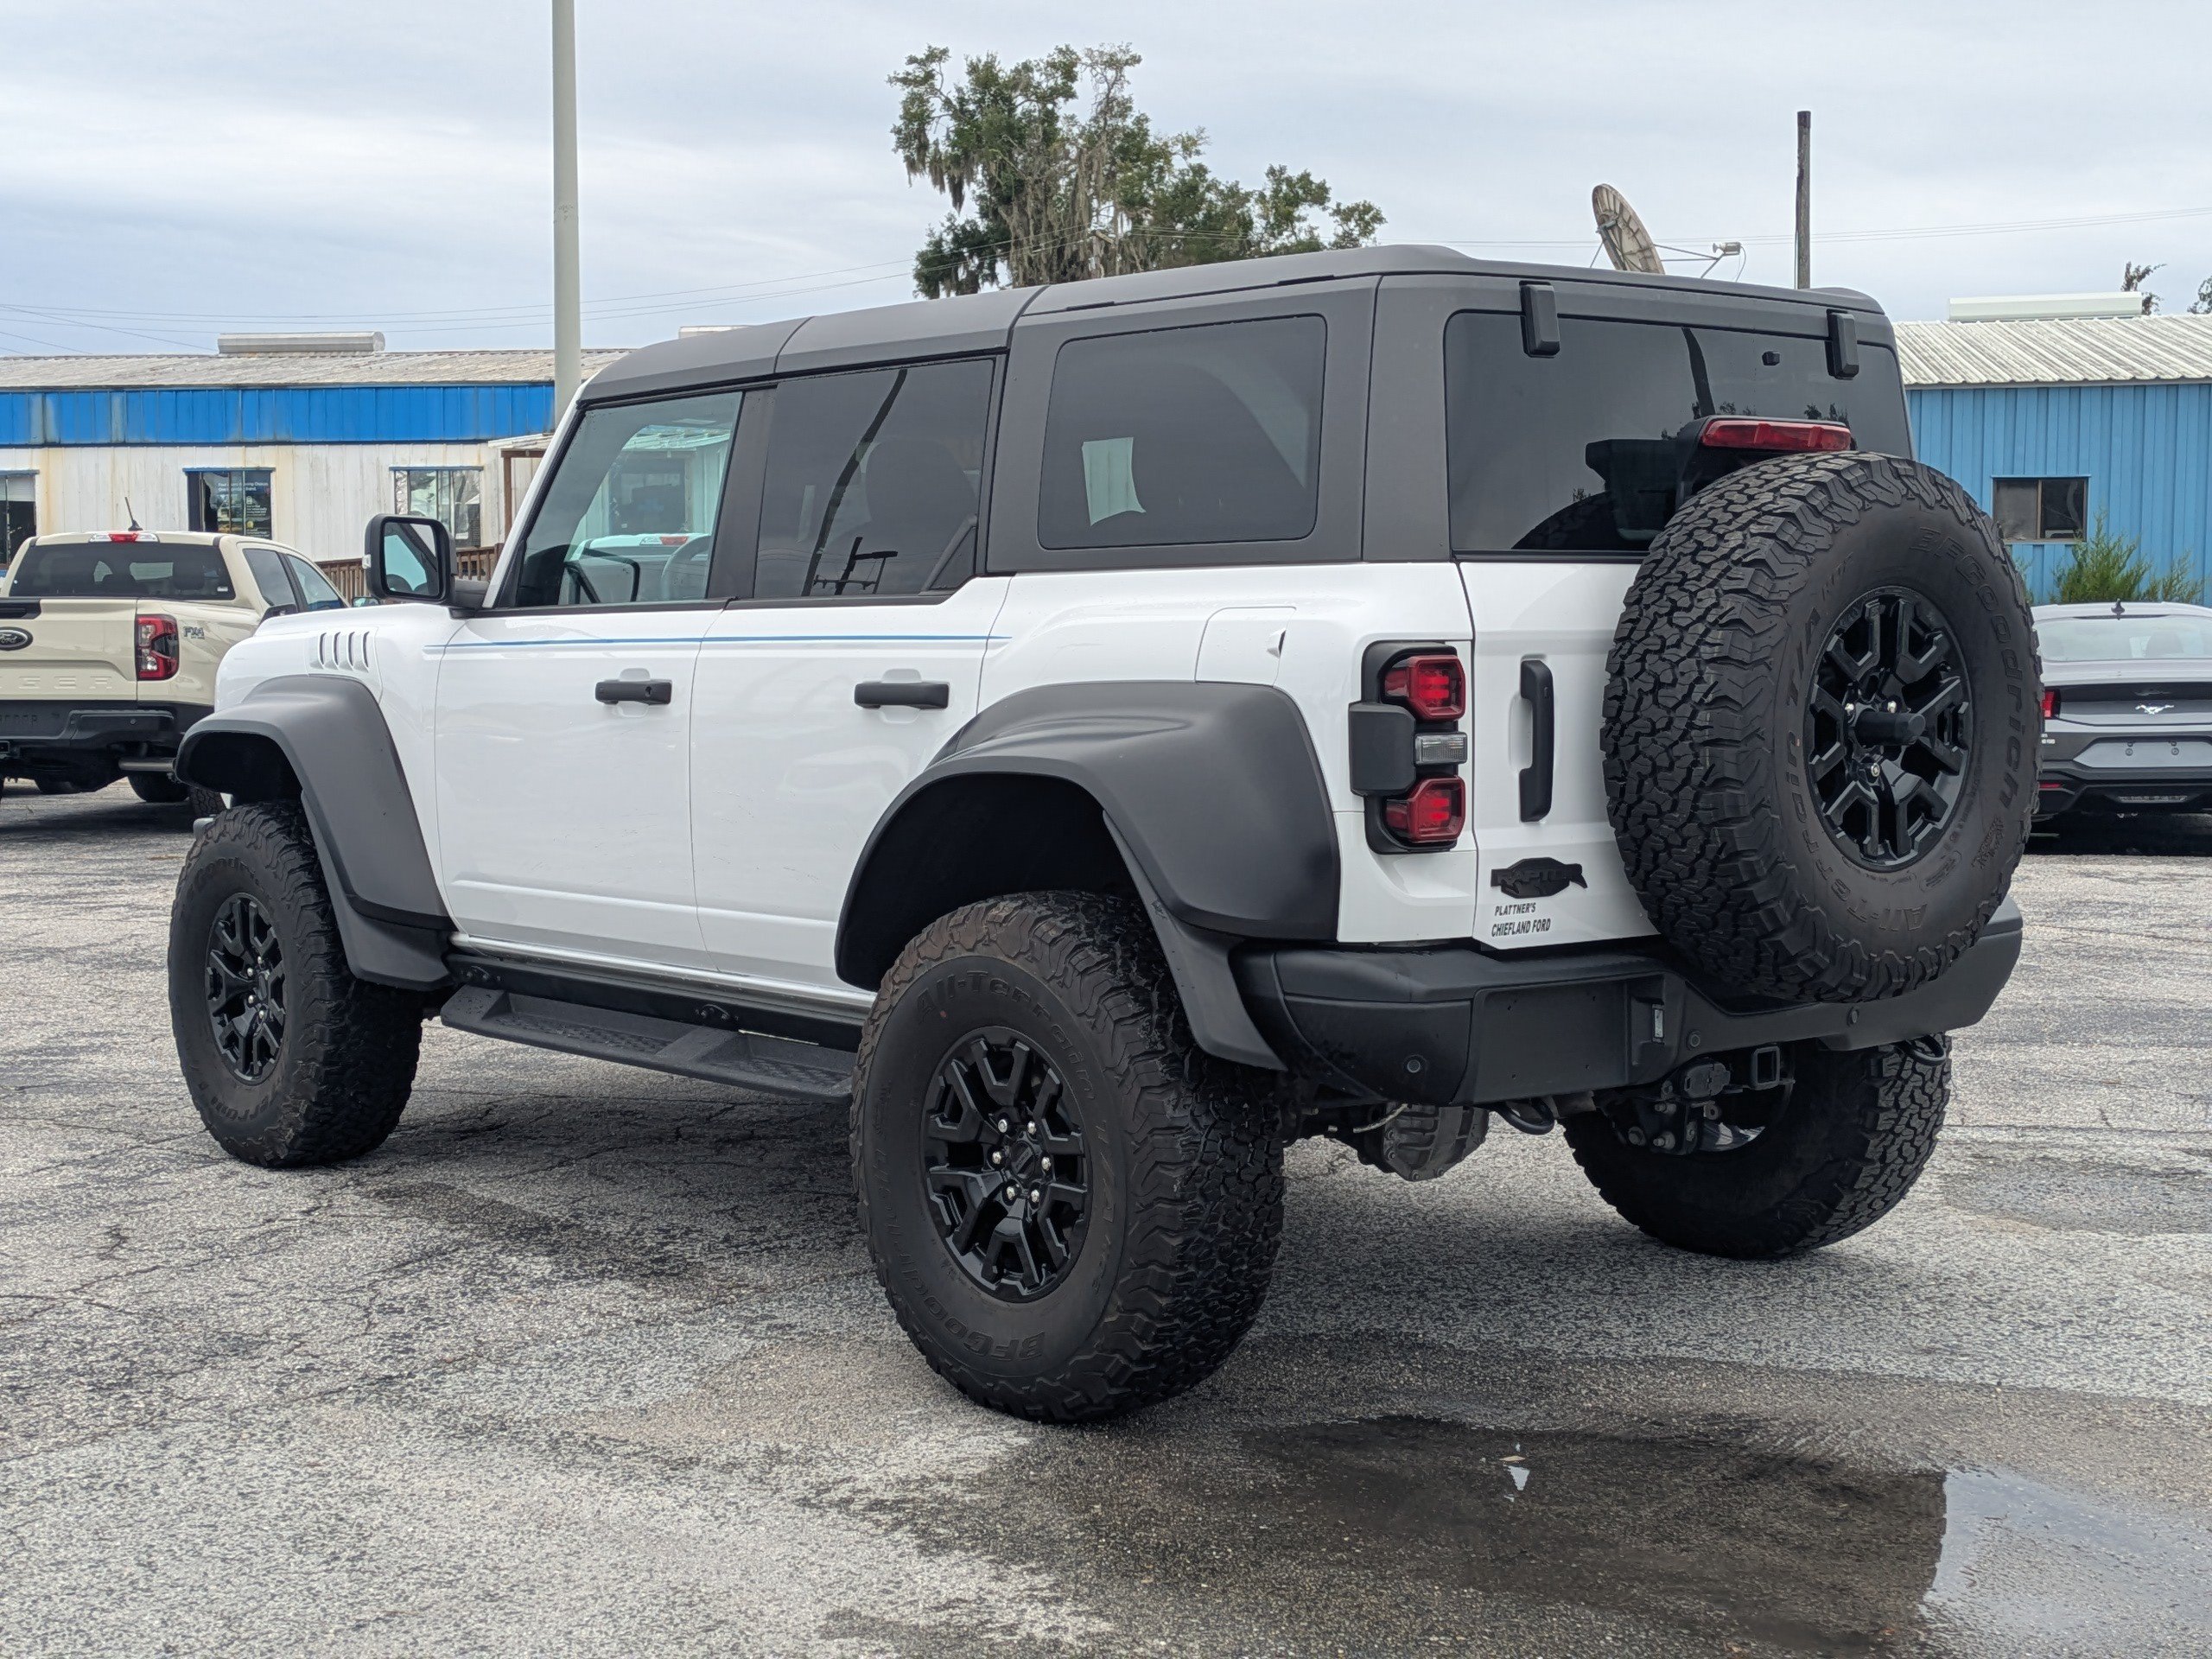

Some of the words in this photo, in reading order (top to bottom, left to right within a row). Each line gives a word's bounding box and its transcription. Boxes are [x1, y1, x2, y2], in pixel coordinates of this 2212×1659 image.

[1910, 526, 2024, 809] BFGoodrich
[1491, 920, 1530, 938] CHIEFLAND
[1532, 918, 1552, 933] FORD
[1494, 902, 1536, 917] PLATTNER'S
[918, 969, 1095, 1099] All-Terrain
